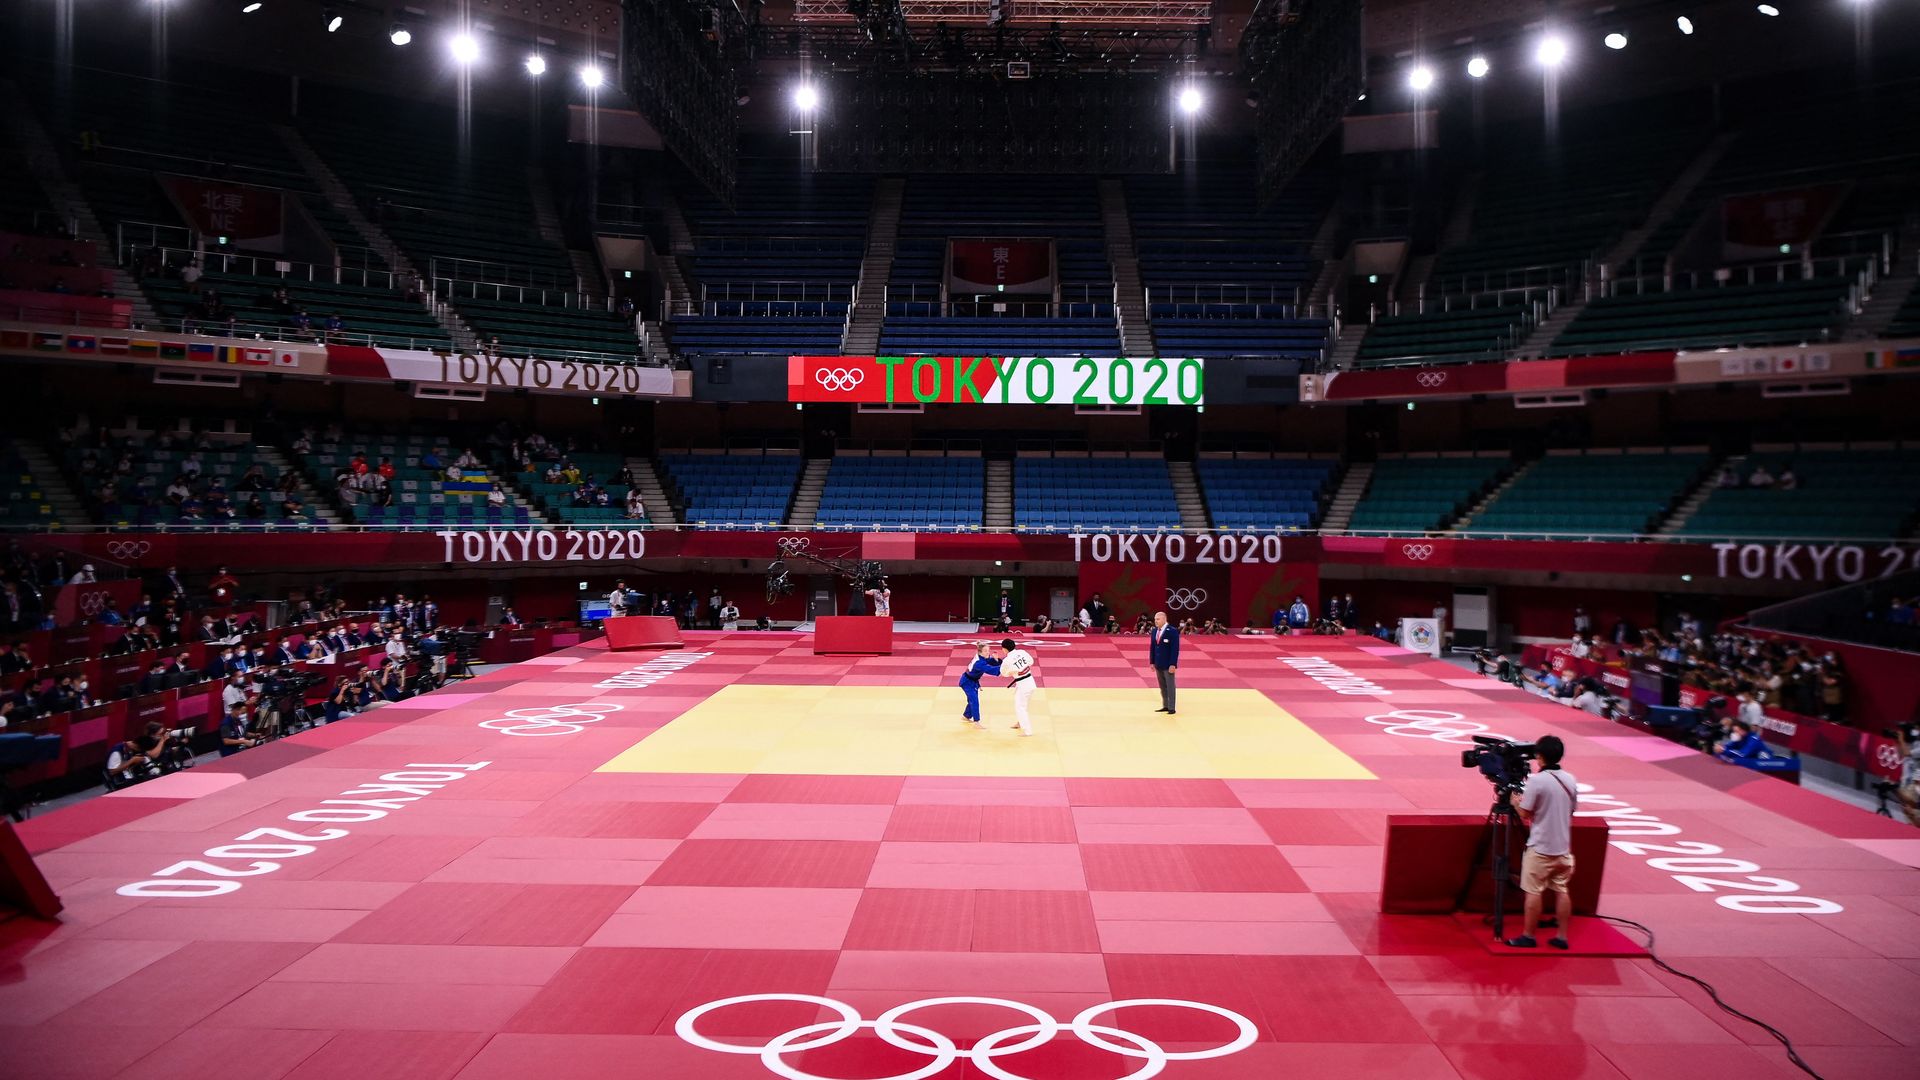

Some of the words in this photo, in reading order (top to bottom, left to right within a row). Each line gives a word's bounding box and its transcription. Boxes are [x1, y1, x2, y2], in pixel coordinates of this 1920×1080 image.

[201, 189, 244, 213] 北東
[210, 211, 235, 232] NE
[992, 246, 1009, 263] 東
[996, 264, 1006, 280] E
[433, 351, 552, 388] TOKYO
[561, 361, 640, 393] 2020
[876, 357, 1054, 403] TOKYO
[1072, 358, 1203, 404] 2020
[436, 530, 557, 562] TOKYO
[565, 530, 645, 560] 2020
[1068, 533, 1186, 562] TOKYO
[1195, 534, 1282, 563] 2020
[1711, 542, 1866, 583] TOKYO
[1013, 656, 1028, 670] TPE
[287, 761, 493, 823] TOKYO
[116, 827, 351, 898] 2020
[1608, 840, 1845, 914] 2020
